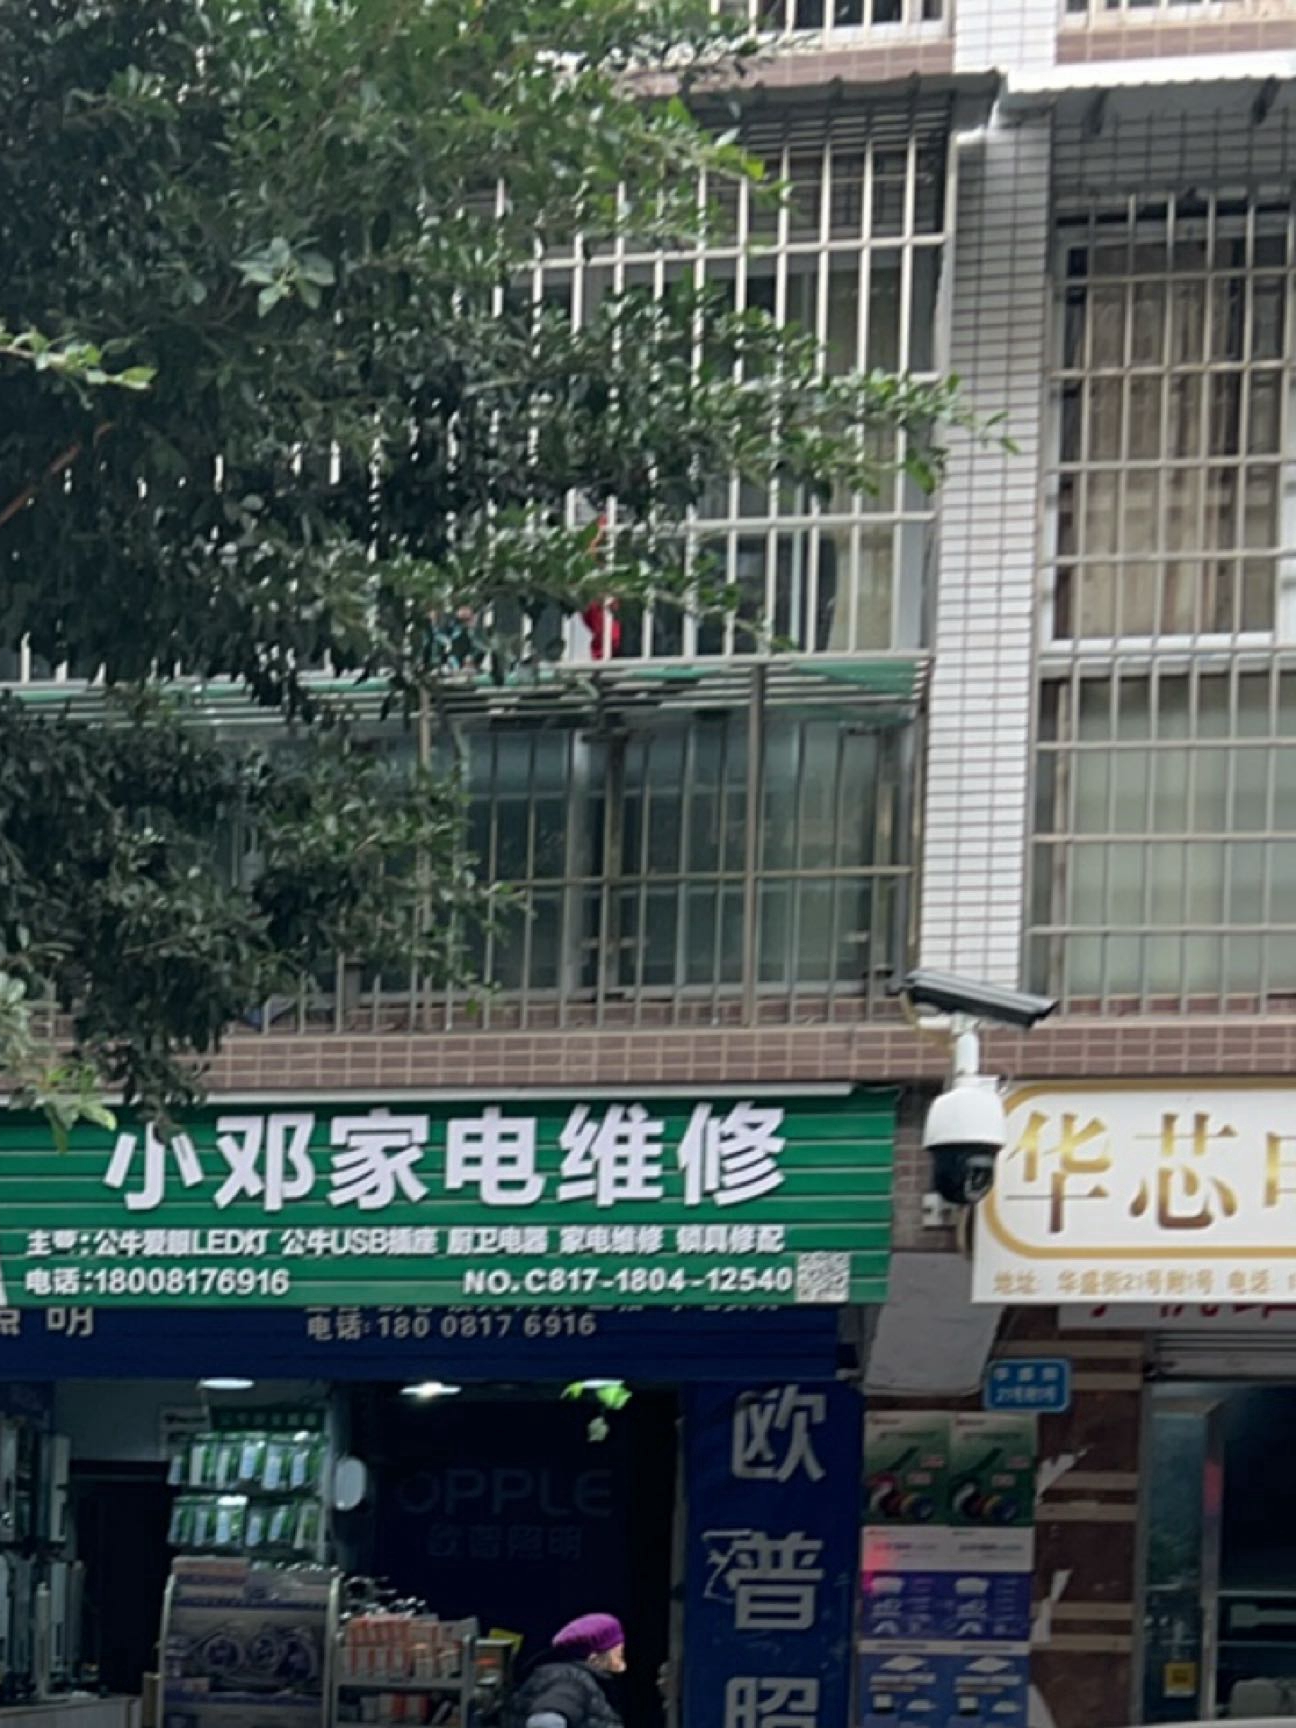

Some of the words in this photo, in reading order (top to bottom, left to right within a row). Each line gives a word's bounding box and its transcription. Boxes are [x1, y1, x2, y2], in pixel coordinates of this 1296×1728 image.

[104, 1103, 786, 1212] 小邓家电维修
[560, 1226, 664, 1254] 家电维修
[26, 1267, 290, 1296] 电话:18008176916
[462, 1267, 793, 1295] NO.C817-1804-12540
[440, 1314, 511, 1337] 0817
[523, 1313, 597, 1335] 6916
[394, 1468, 611, 1518] OPPLE
